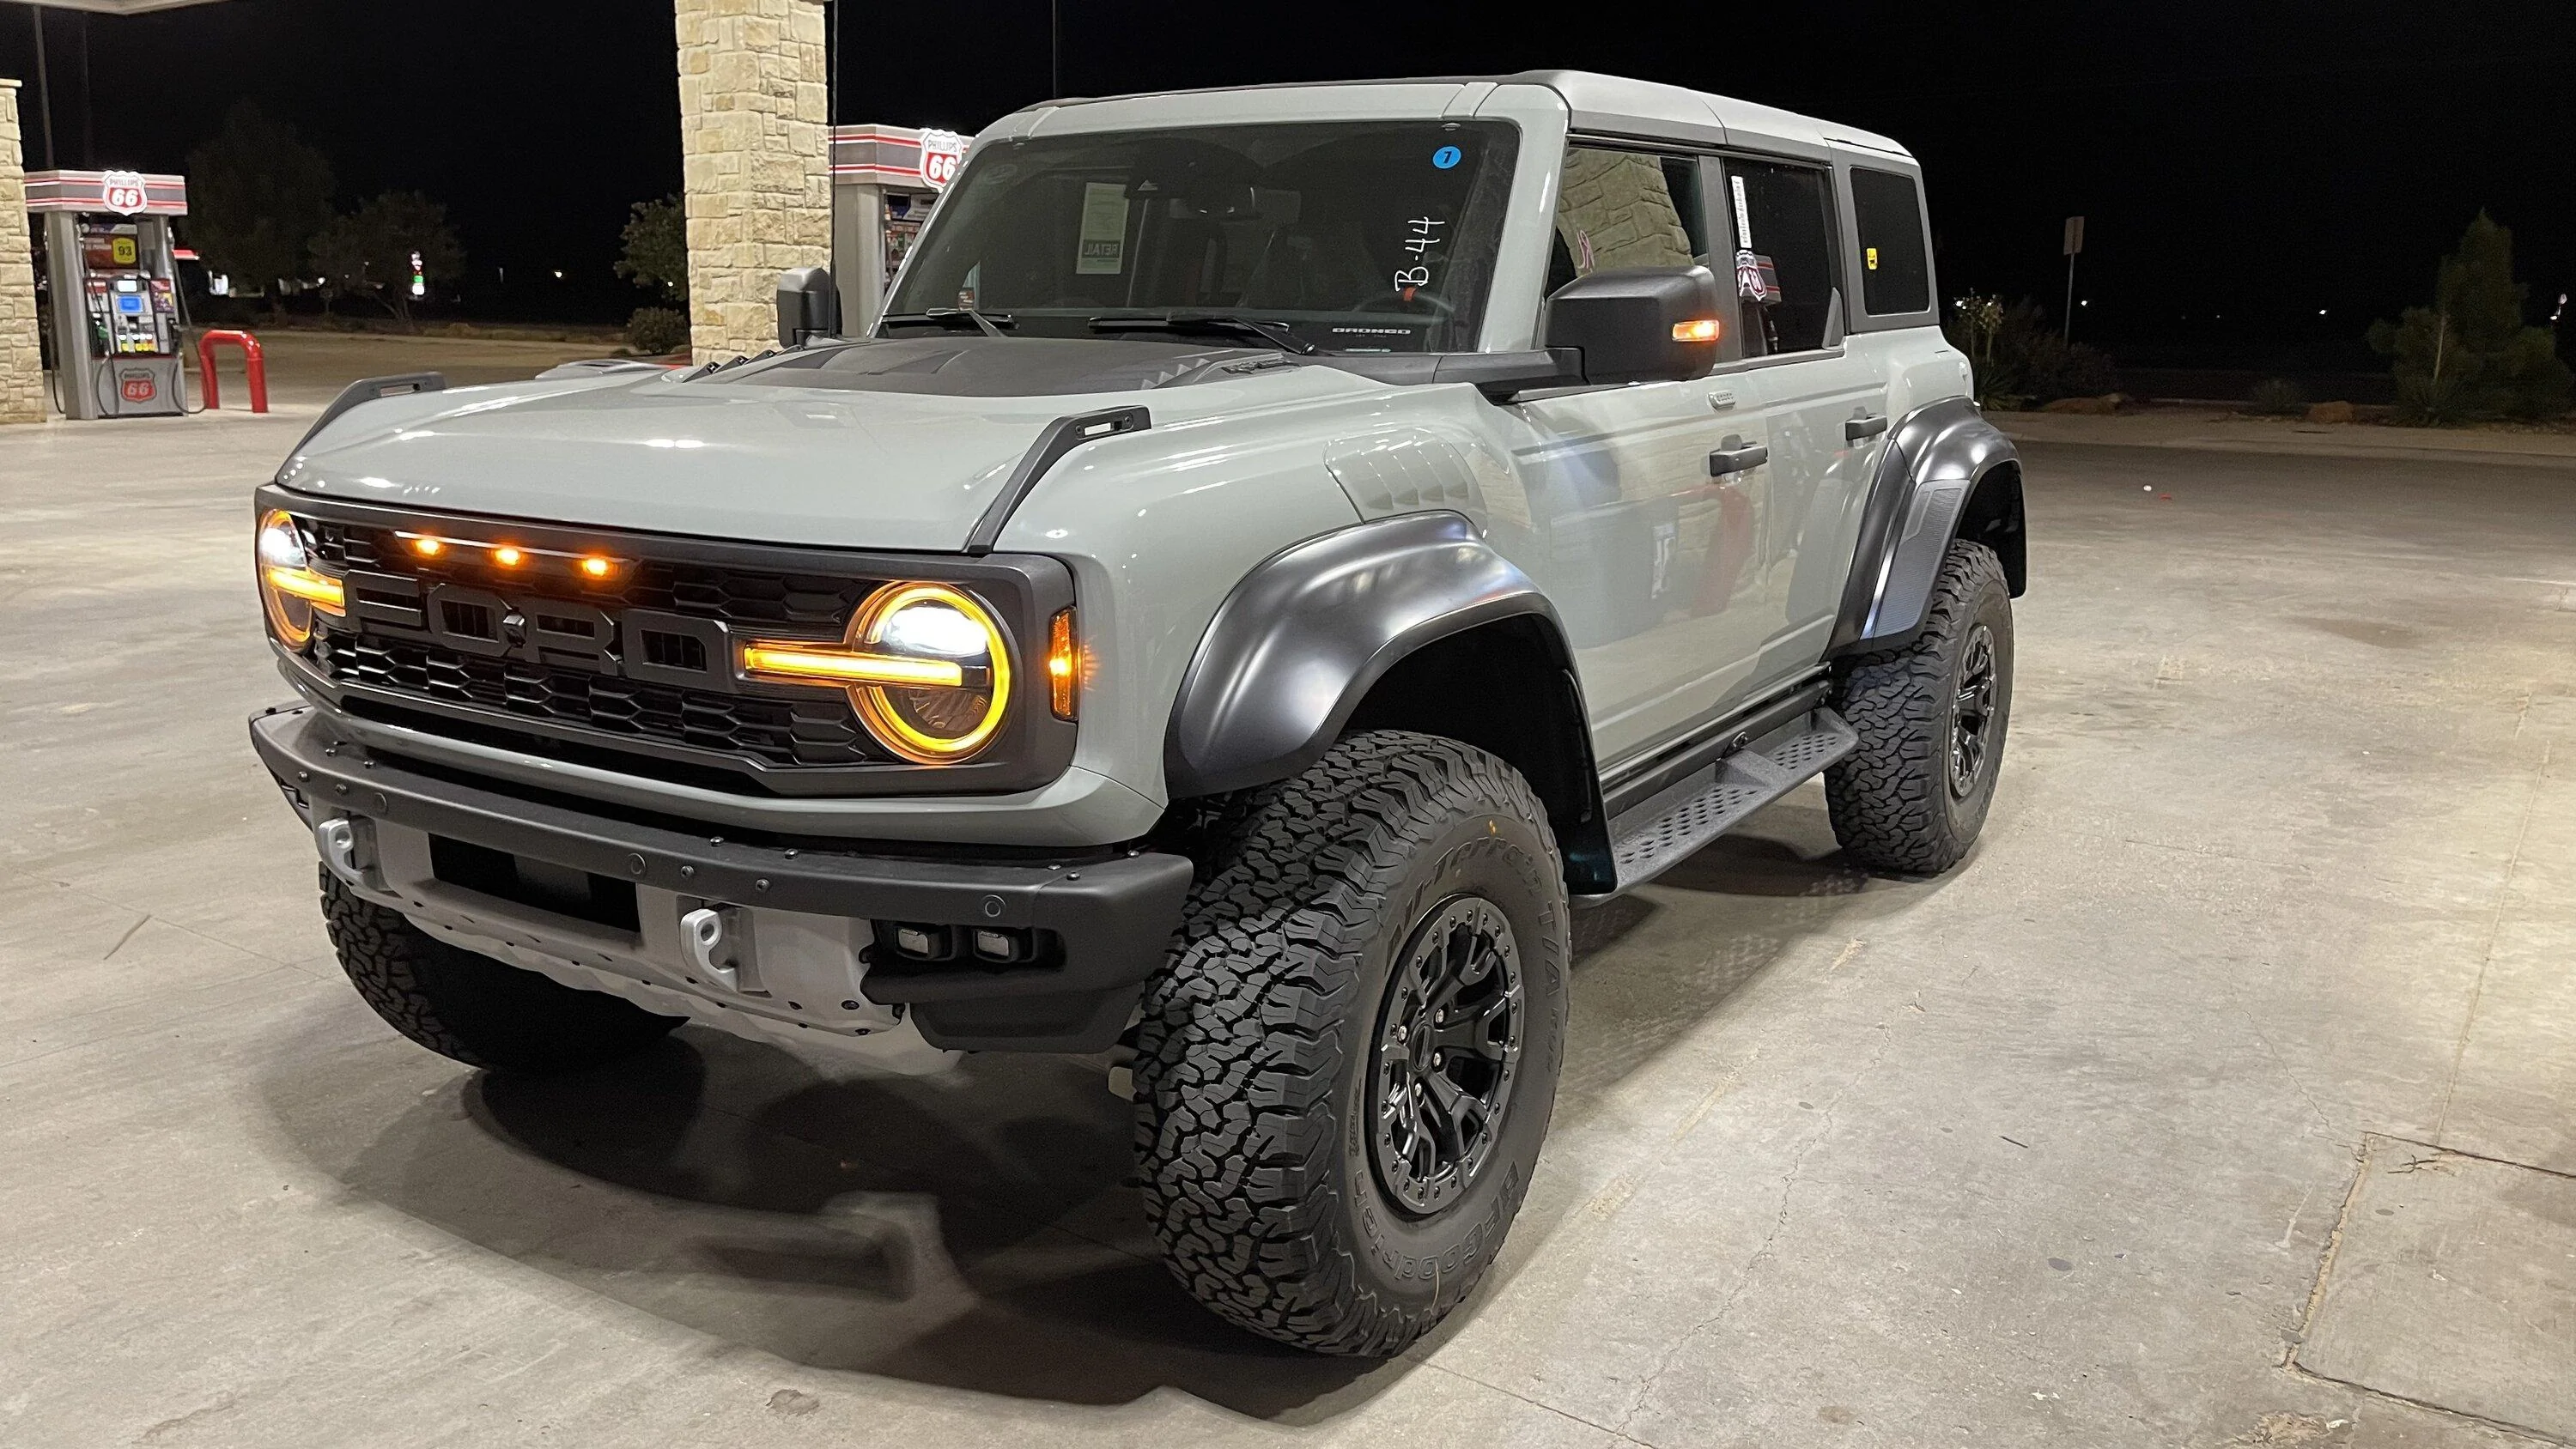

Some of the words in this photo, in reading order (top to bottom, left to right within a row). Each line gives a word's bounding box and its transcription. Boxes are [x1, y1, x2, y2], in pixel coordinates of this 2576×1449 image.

[927, 140, 957, 154] PHILLIPS
[1443, 150, 1453, 164] 7
[928, 155, 957, 181] 66
[112, 188, 138, 207] 66
[118, 246, 132, 257] 93
[128, 382, 150, 397] 66
[344, 569, 730, 694] FORD
